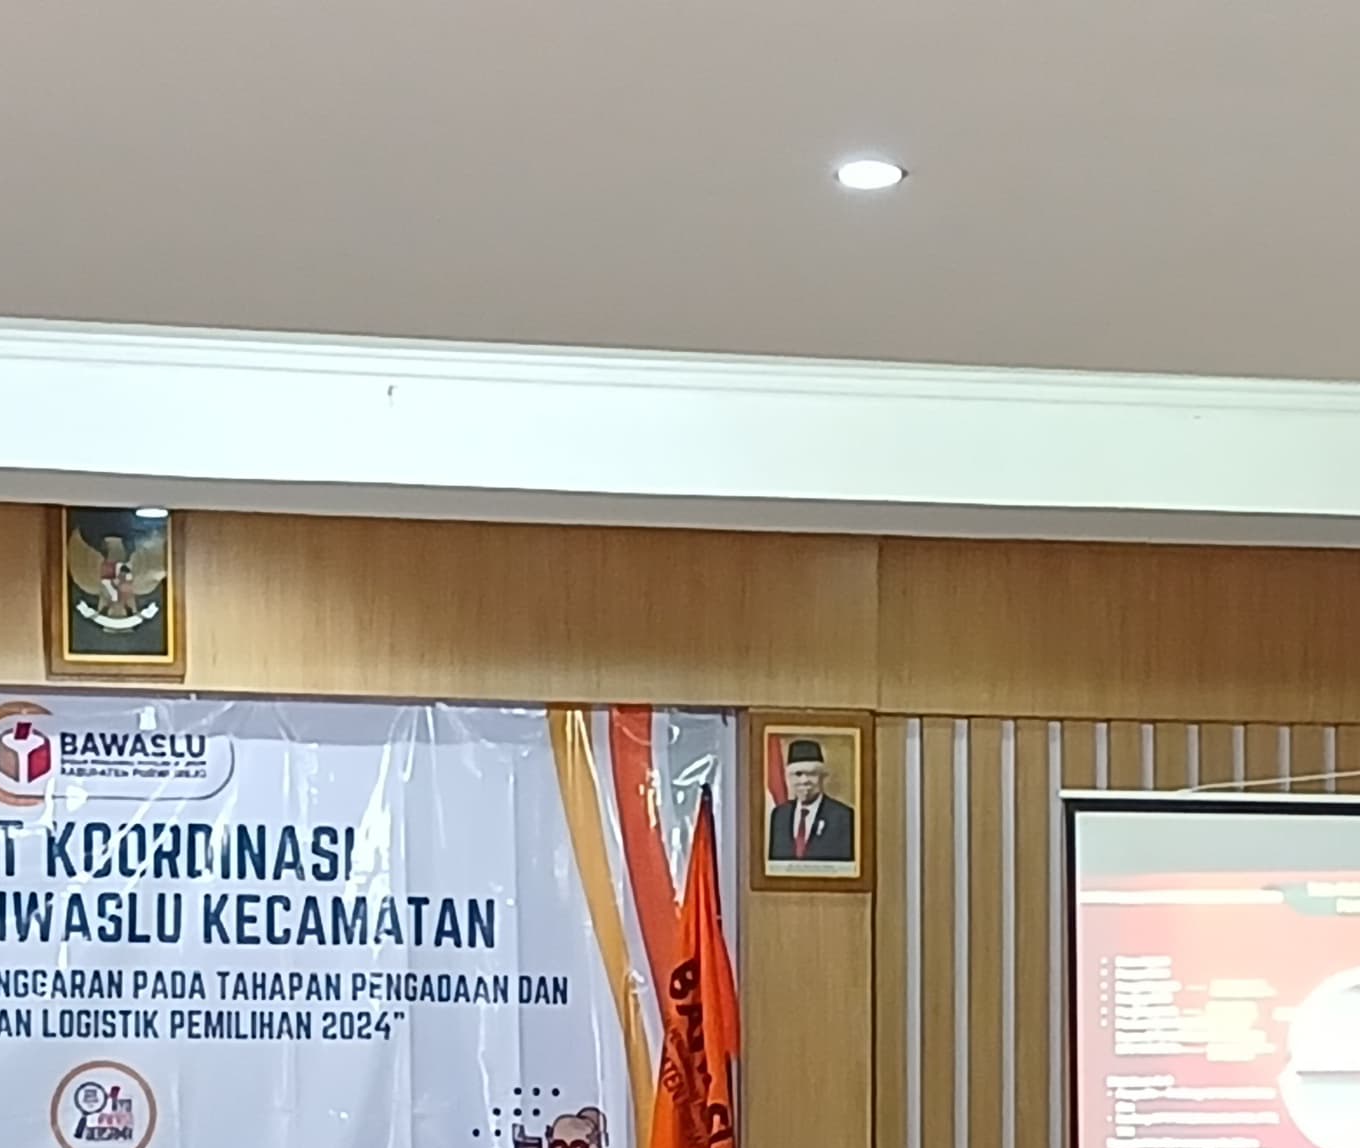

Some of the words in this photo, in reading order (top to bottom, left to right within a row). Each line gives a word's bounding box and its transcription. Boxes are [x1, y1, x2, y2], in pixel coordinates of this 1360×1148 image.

[60, 732, 206, 758] BAWASLU
[46, 821, 355, 881] KOORDINASI
[202, 892, 495, 949] KECAMATAN
[133, 970, 205, 1000] PADA
[217, 971, 341, 1002] TAHAPAN
[351, 972, 509, 1004] PENGADAAN
[518, 975, 569, 1005] DAN
[42, 1008, 159, 1039] LOGISTIK
[169, 1010, 312, 1040] PEMILIHAN
